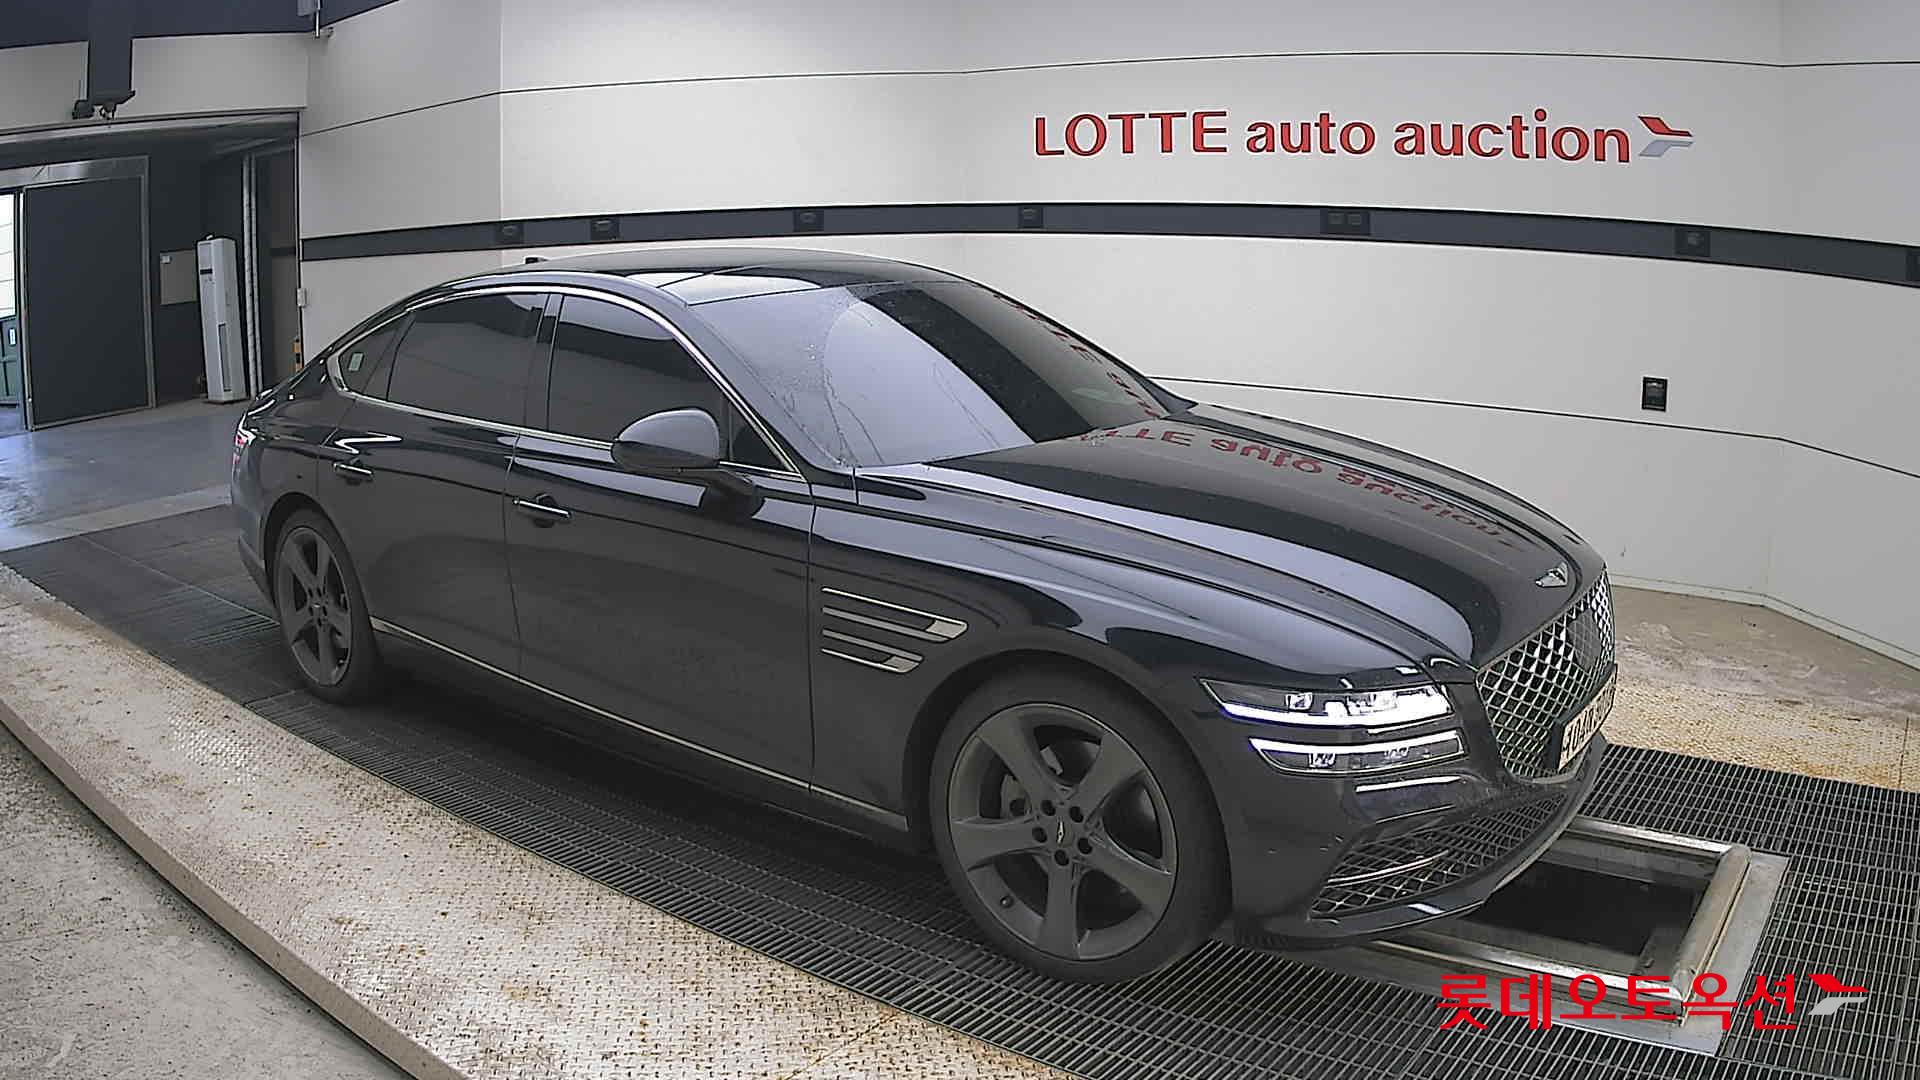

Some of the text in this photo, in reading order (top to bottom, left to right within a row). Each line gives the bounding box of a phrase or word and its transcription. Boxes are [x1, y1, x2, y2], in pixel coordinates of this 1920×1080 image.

[1035, 108, 1630, 162] LOTTE auto auction
